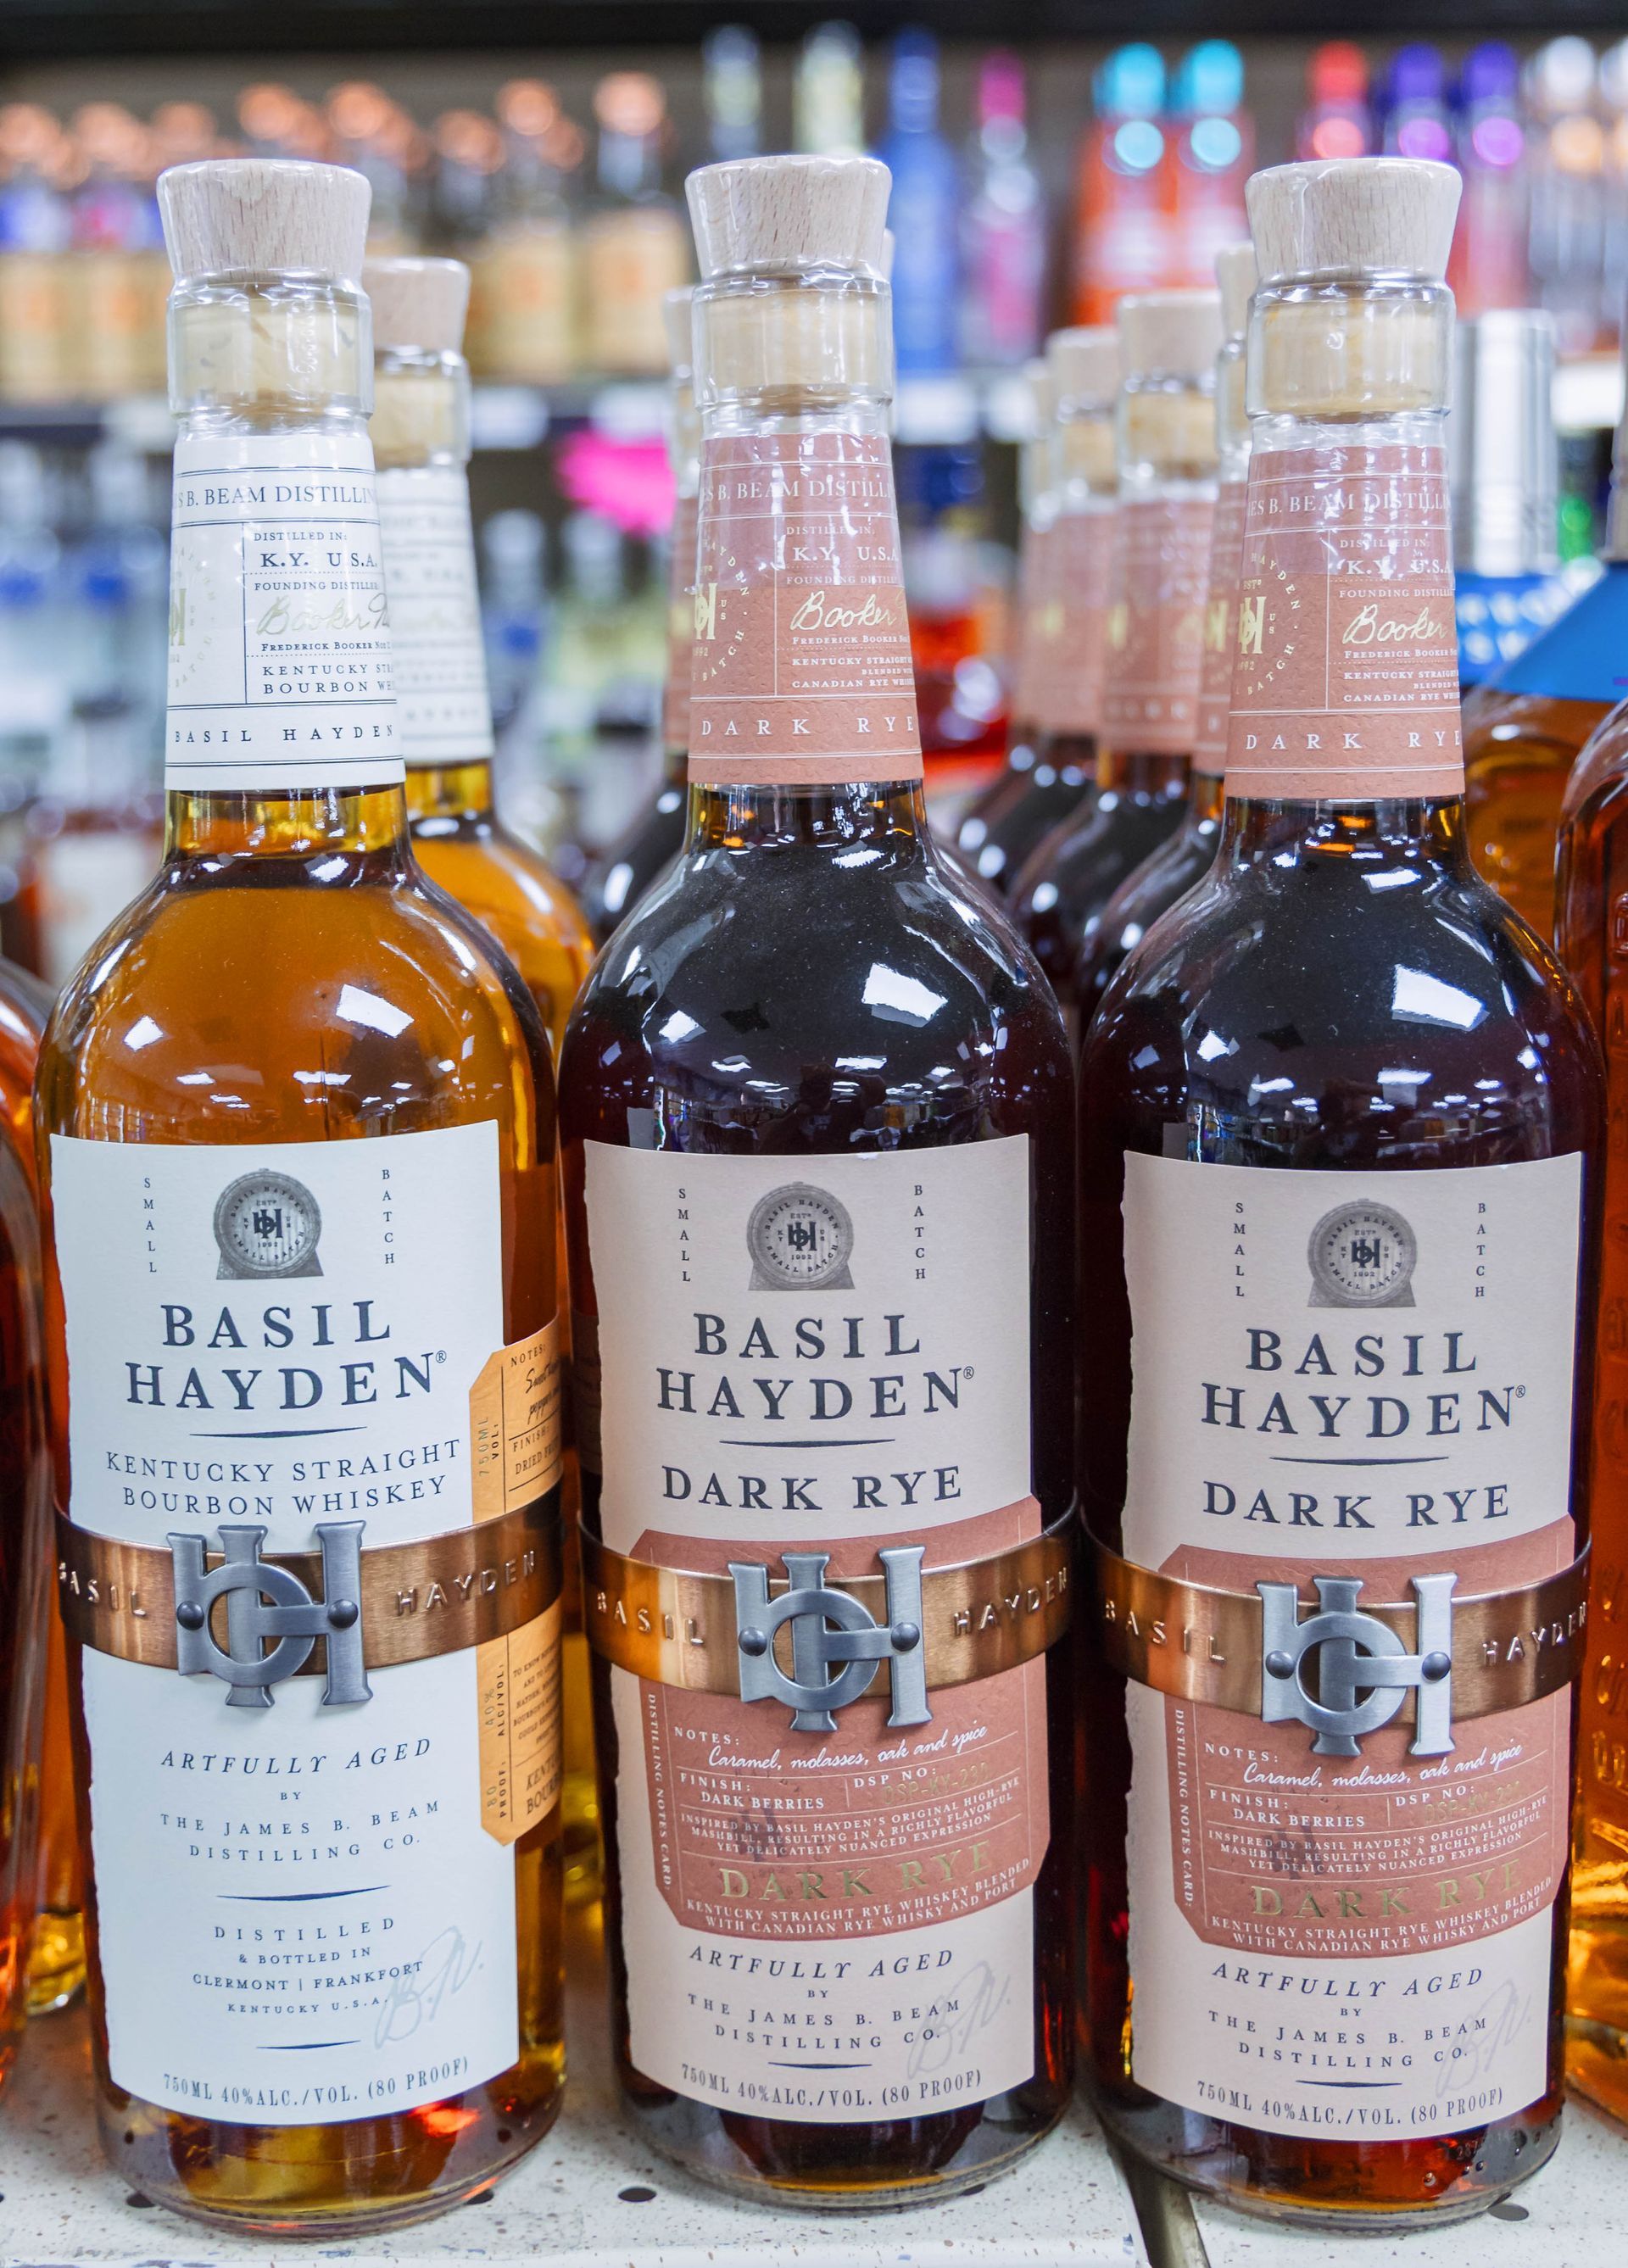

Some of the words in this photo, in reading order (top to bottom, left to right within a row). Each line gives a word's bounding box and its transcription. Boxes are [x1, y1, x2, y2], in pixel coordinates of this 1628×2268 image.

[204, 488, 265, 505] BEAM
[260, 554, 309, 567] K.Y.
[263, 666, 368, 675] KENTUCKY
[792, 657, 861, 666] KENTUCKY
[264, 683, 368, 694] BOURBON
[176, 731, 251, 743] BASIL
[283, 725, 393, 741] HAYDEN
[702, 718, 811, 736] DARK
[856, 716, 913, 733] RYE
[1246, 733, 1363, 749] DARK
[1408, 731, 1460, 748] RYE
[144, 1179, 156, 1273] SMALL
[382, 1170, 394, 1264] BATCH
[914, 1185, 925, 1279] BATCH
[678, 1189, 690, 1282] SMALL
[1235, 1203, 1246, 1297] SMALL
[1475, 1203, 1486, 1296] BATCH
[161, 1301, 390, 1348] BASIL
[693, 1313, 920, 1359] BASIL
[510, 1344, 546, 1368] NOTES:
[1246, 1329, 1476, 1377] BASIL
[107, 1452, 275, 1482] KENTUCKY
[293, 1439, 460, 1482] STRAIGHT
[123, 1487, 274, 1514] BOURBON
[293, 1475, 446, 1513] WHISKEY
[661, 1466, 822, 1511] DARK
[853, 1466, 962, 1509] RYE
[1203, 1481, 1374, 1528] DARK
[1406, 1484, 1508, 1527] RYE
[395, 1550, 536, 1616] HAYDEN
[648, 1694, 662, 1782] DISTILLING
[674, 1726, 739, 1747] NOTES:
[708, 1746, 782, 1770] Caramel,
[790, 1749, 869, 1769] molasses,
[878, 1739, 909, 1762] oak
[914, 1729, 947, 1757] and
[951, 1719, 987, 1756] spice
[1205, 1743, 1279, 1763] NOTES:
[161, 1751, 326, 1775] ARTFULLY
[346, 1738, 432, 1769] AGED
[1244, 1762, 1322, 1787] Caramel,
[1331, 1766, 1411, 1786] molasses,
[1420, 1756, 1451, 1780] oak
[1455, 1747, 1486, 1772] and
[1491, 1738, 1522, 1772] spice
[681, 1773, 751, 1792] FINISH:
[854, 1773, 889, 1789] DSP
[901, 1767, 936, 1780] NO:
[281, 1792, 302, 1801] BY
[655, 1788, 668, 1837] NOTES
[682, 1814, 739, 1831] INSPIRED
[767, 1821, 808, 1833] BASIL
[814, 1814, 886, 1831] HAYDEN'S
[891, 1801, 959, 1823] ORIGINAL
[963, 1776, 1020, 1808] HIGH-RYE
[701, 1792, 748, 1808] DARK
[751, 1797, 824, 1810] BERRIES
[1209, 1790, 1290, 1809] FINISH:
[161, 1814, 204, 1831] THE
[224, 1822, 309, 1836] JAMES
[334, 1819, 349, 1831] B.
[371, 1801, 439, 1826] BEAM
[717, 1842, 744, 1852] YET
[747, 1843, 832, 1856] DELICATELY
[839, 1837, 908, 1854] NUANCED
[913, 1813, 991, 1844] EXPRESSION
[767, 1831, 847, 1845] RESULTING
[854, 1830, 867, 1840] IN
[890, 1817, 942, 1836] RICHLY
[946, 1793, 1012, 1822] FLAVORFUL
[1234, 1808, 1285, 1825] DARK
[1289, 1814, 1365, 1827] BERRIES
[190, 1844, 360, 1861] DISTILLING
[384, 1834, 421, 1849] CO.
[660, 1842, 672, 1892] CARD:
[719, 1868, 874, 1903] DARK
[900, 1842, 991, 1892] RYE
[688, 1899, 763, 1920] KENTUCKY
[771, 1909, 854, 1921] STRAIGHT
[862, 1904, 893, 1918] RYE
[899, 1887, 968, 1913] WHISKEY
[1252, 1885, 1415, 1919] DARK
[1437, 1858, 1521, 1909] RYE
[215, 1918, 394, 1942] DISTILLED
[705, 1916, 746, 1931] WITH
[752, 1920, 835, 1933] CANADIAN
[845, 1918, 874, 1931] RYE
[883, 1907, 944, 1927] WHISKY
[238, 1953, 248, 1964] &
[259, 1951, 340, 1964] BOTTLED
[352, 1948, 371, 1957] IN
[690, 1946, 850, 1979] ARTFULLY
[868, 1950, 952, 1977] AGED
[193, 1974, 289, 1991] CLERMONT
[315, 1961, 423, 1989] FRANKFORT
[1213, 1963, 1385, 1998] ARTFULLY
[1402, 1968, 1482, 1996] AGED
[228, 2003, 320, 2014] KENTUCKY
[332, 1997, 388, 2010] U.S.A.
[689, 1994, 729, 2015] THE
[749, 2009, 833, 2026] JAMES
[856, 2014, 872, 2025] B.
[893, 2000, 960, 2021] BEAM
[716, 2025, 882, 2049] DISTILLING
[904, 2029, 940, 2043] CO.
[1209, 2010, 1256, 2033] THE
[1276, 2026, 1365, 2044] JAMES
[1389, 2032, 1403, 2043] B.
[1424, 2018, 1487, 2041] BEAM
[1240, 2041, 1413, 2068] DISTILLING
[1435, 2047, 1467, 2063] CO.
[164, 2073, 213, 2101] 750ML
[368, 2076, 396, 2099] (80
[407, 2057, 468, 2091] PROOF)
[682, 2064, 729, 2094] 750ML
[883, 2085, 909, 2107] (80
[919, 2069, 981, 2098] PROOF)
[1197, 2081, 1252, 2111] 750ML
[1412, 2103, 1437, 2124] (80
[1447, 2087, 1502, 2117] PROOF)
